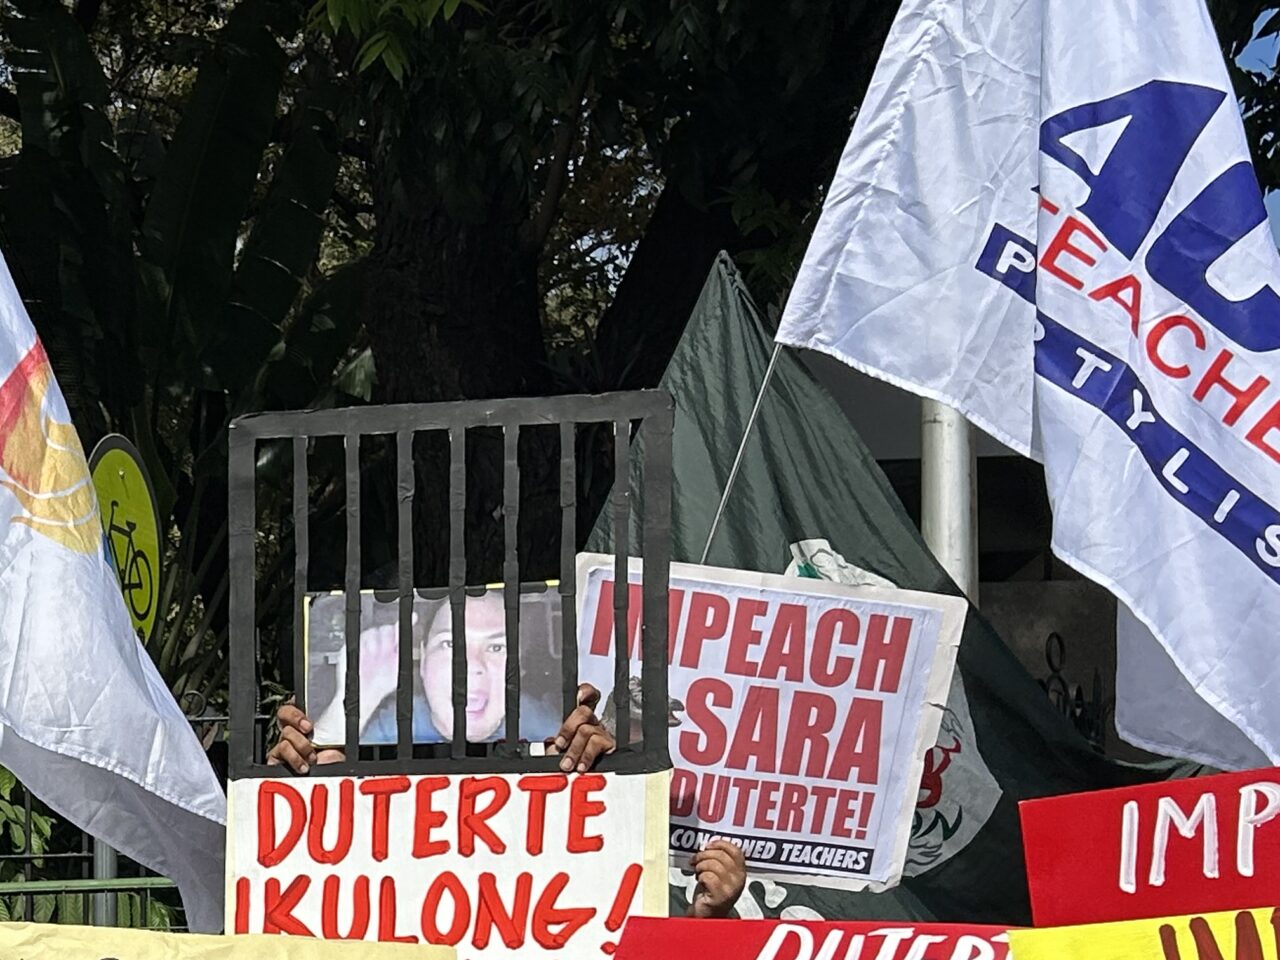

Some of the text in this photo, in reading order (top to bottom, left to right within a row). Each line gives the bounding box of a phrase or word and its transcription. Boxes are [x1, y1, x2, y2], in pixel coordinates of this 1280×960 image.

[679, 678, 883, 785] SARA
[257, 774, 606, 868] DUTERTE
[670, 769, 876, 840] DUTERTE!
[780, 843, 869, 870] TEACHERS
[234, 863, 643, 955] IKULONG!
